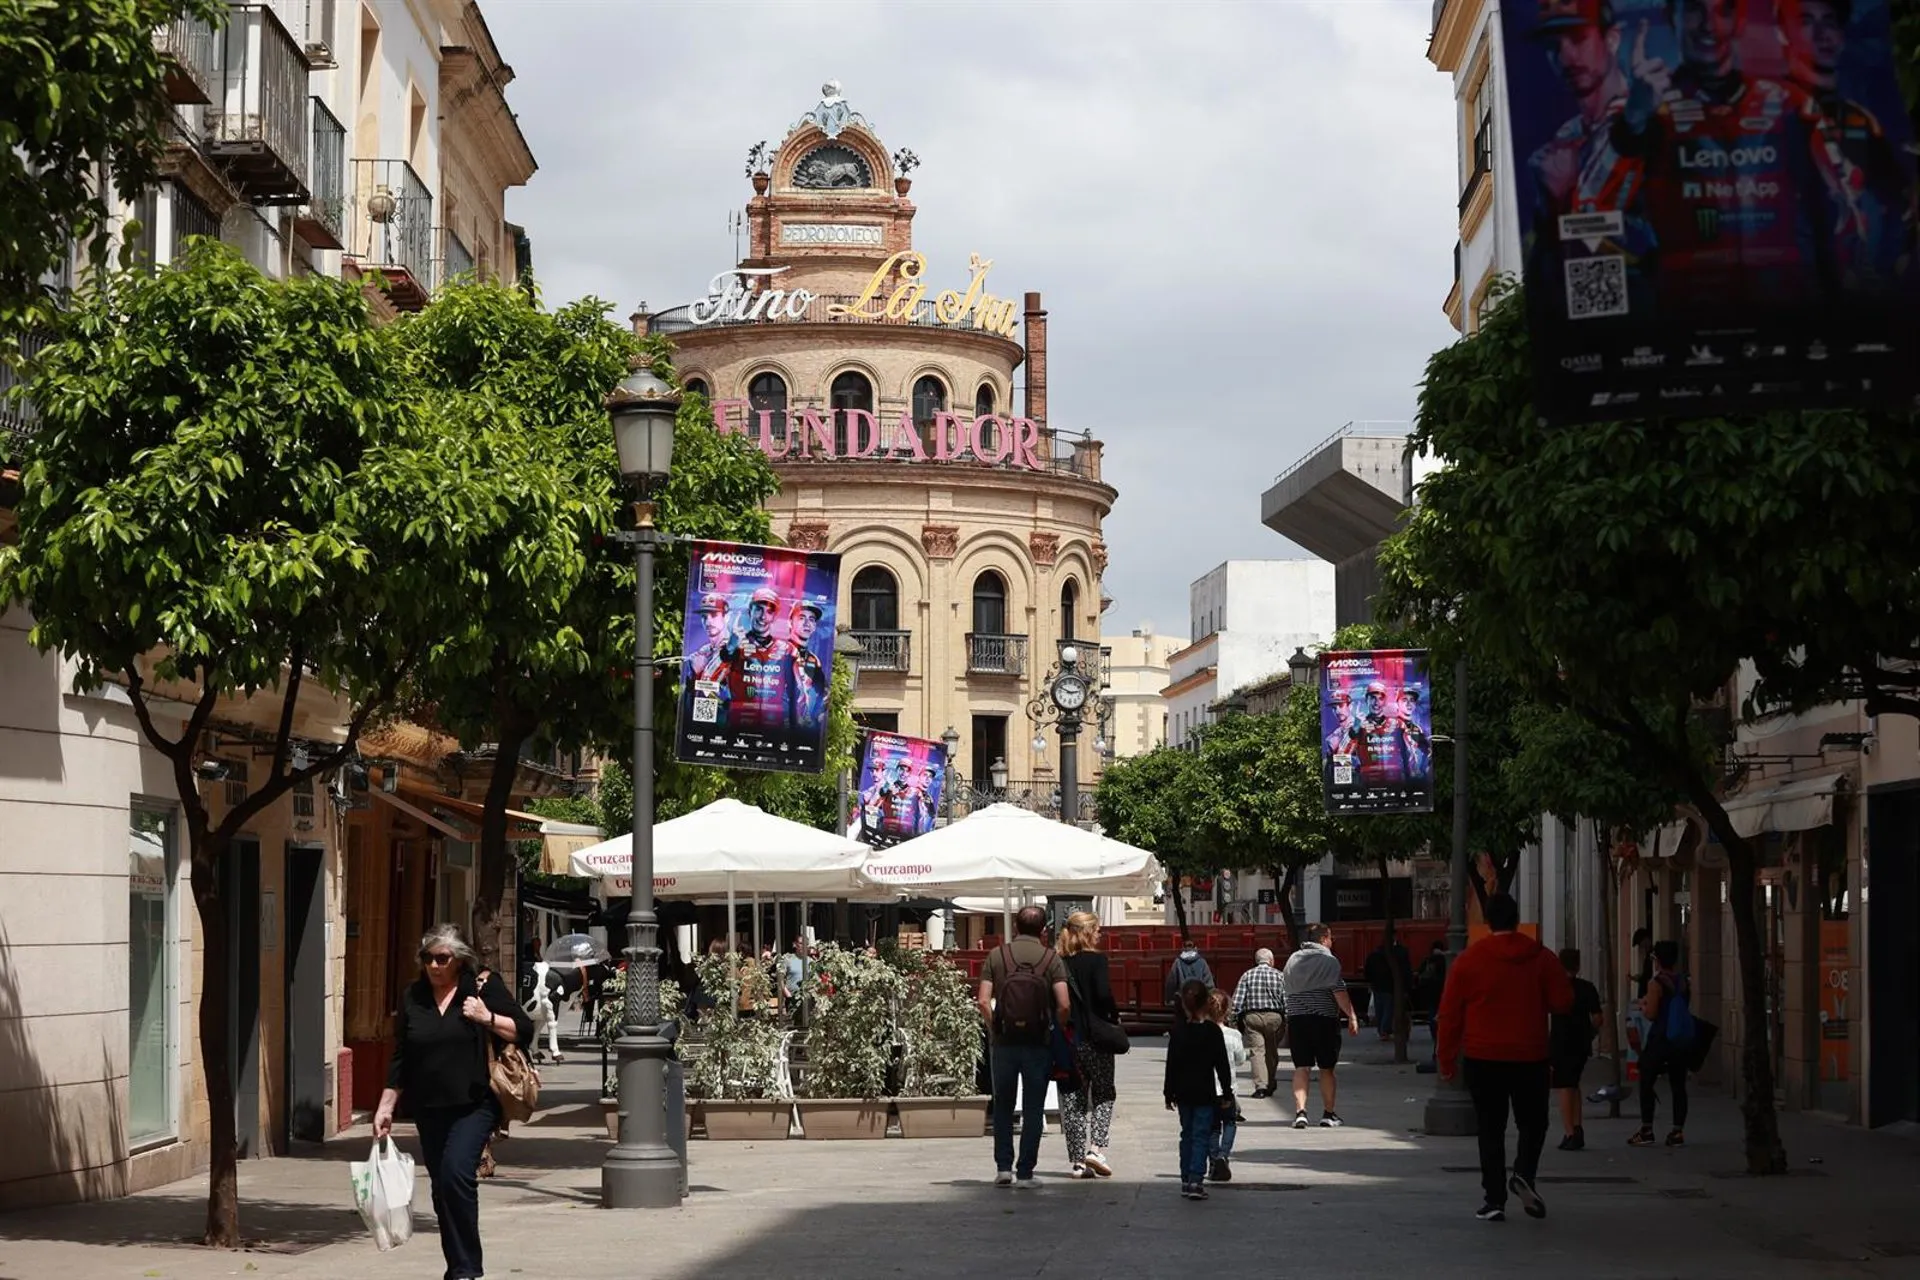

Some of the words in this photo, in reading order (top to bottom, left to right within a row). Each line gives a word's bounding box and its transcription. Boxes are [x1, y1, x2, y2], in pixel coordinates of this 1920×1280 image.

[1679, 144, 1777, 169] Lenovo
[784, 227, 826, 242] PEDRO
[689, 264, 819, 326] Fino
[827, 250, 931, 321] La
[1560, 354, 1602, 368] QATAR
[1620, 354, 1665, 366] TISSOT
[711, 400, 1042, 472] FUNDADOR
[744, 661, 780, 673] Lenovo
[867, 864, 932, 875] Cruzcampo
